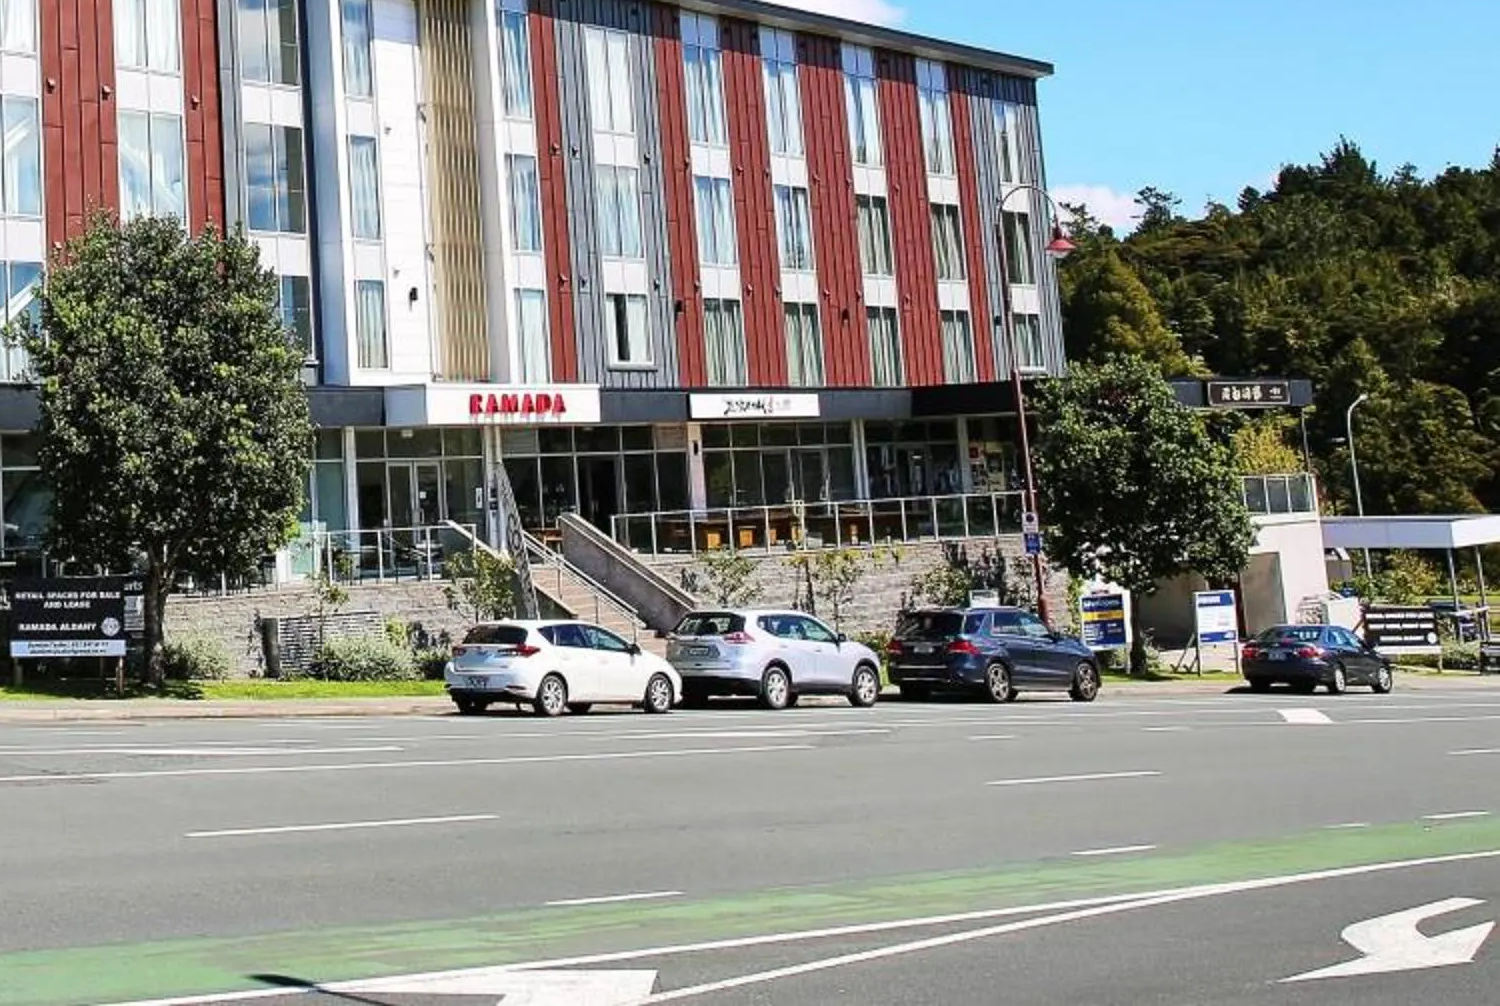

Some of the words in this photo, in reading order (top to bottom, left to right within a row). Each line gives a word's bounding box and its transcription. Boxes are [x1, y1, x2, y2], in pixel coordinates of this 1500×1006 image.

[469, 393, 566, 415] RAMADA
[43, 601, 62, 609] AND
[63, 601, 91, 609] LEASE
[18, 623, 58, 631] RAMADA
